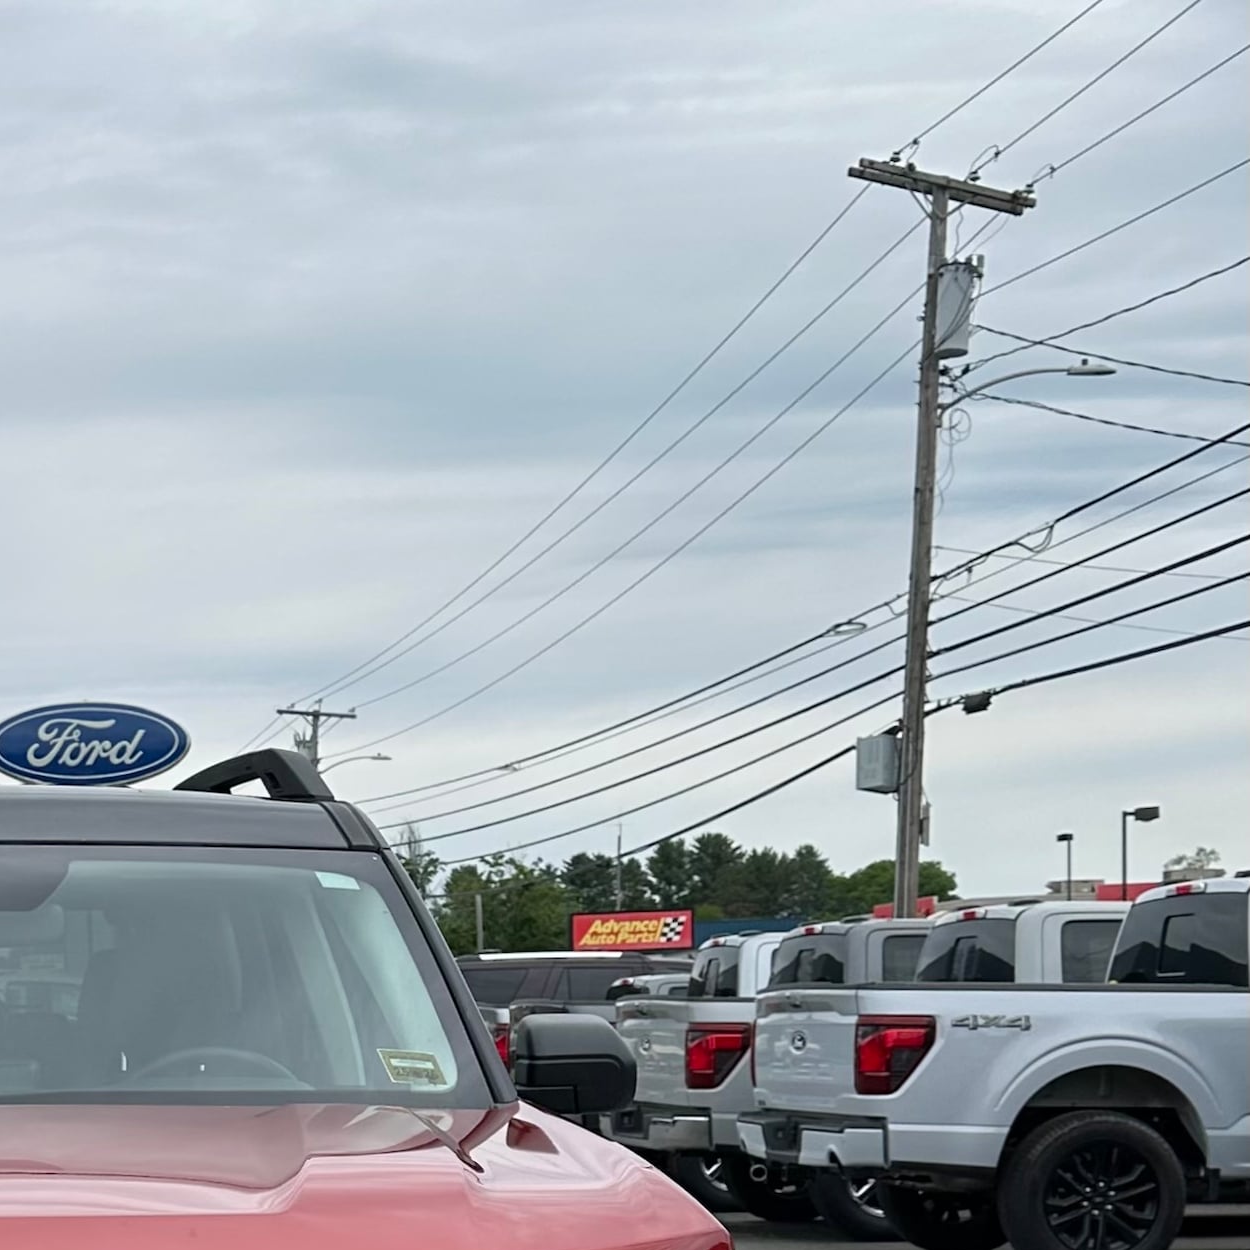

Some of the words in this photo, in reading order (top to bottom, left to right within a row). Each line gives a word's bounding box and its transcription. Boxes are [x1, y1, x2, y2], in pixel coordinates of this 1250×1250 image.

[26, 718, 146, 767] Ford
[588, 918, 659, 933] Advance
[579, 934, 616, 945] Auto
[617, 931, 656, 944] Parts
